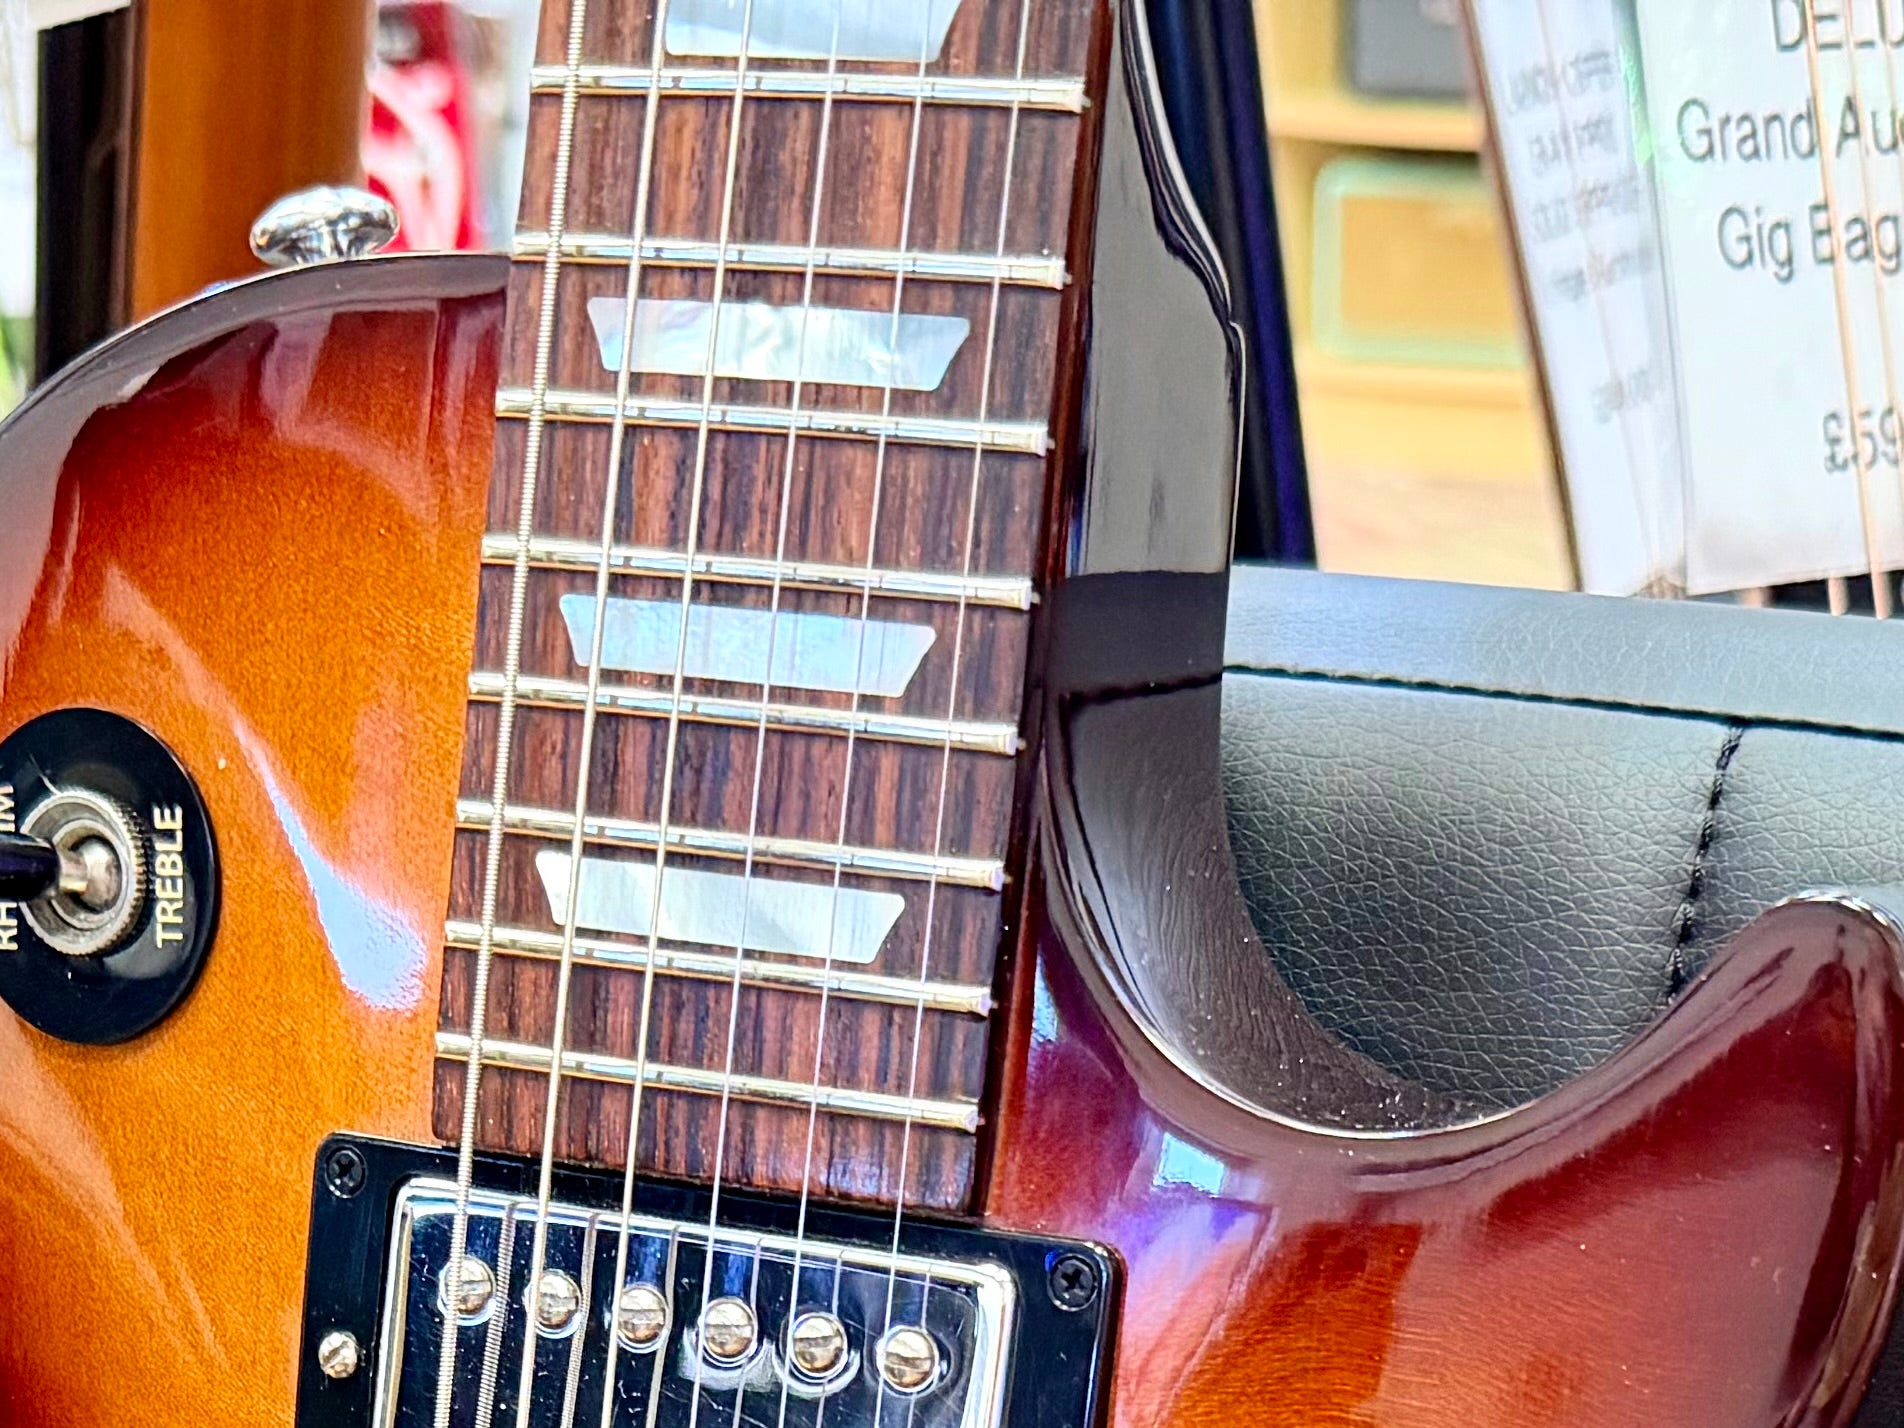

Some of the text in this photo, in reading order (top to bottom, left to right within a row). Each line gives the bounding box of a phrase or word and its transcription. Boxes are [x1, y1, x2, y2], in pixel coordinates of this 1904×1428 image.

[1676, 96, 1820, 162] Grand
[1717, 201, 1795, 284] Gig
[1809, 200, 1903, 276] Bag
[153, 803, 184, 949] TREBLE
